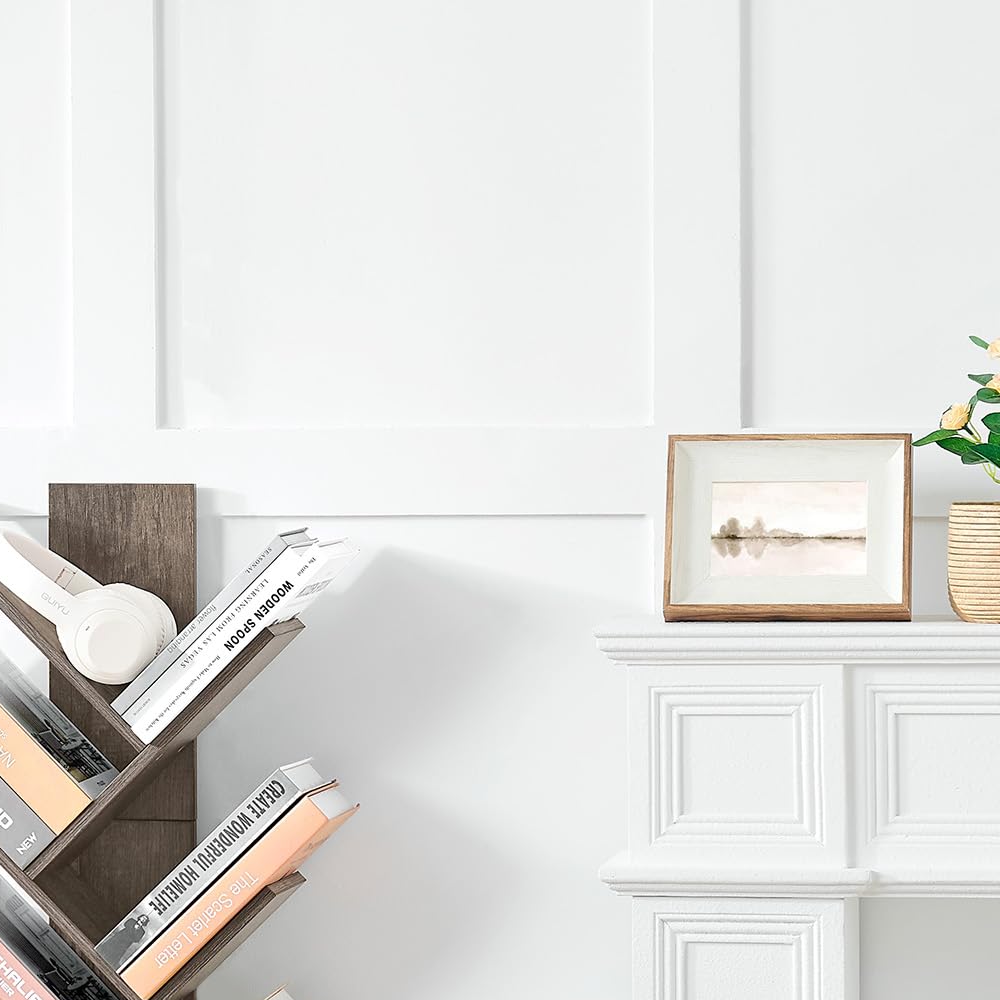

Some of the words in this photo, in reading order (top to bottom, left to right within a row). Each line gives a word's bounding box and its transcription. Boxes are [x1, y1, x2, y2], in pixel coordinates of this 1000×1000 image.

[235, 579, 269, 611] LEARNING
[254, 581, 294, 620] WOODEN
[197, 604, 217, 624] flower
[216, 612, 235, 632] FROM
[167, 622, 197, 654] arranging
[203, 632, 216, 644] LAS
[224, 619, 256, 651] SPOON
[180, 647, 203, 667] VEGAS
[246, 780, 285, 819] CREATE
[16, 832, 39, 855] NEW
[192, 812, 255, 871] WONDERFUL
[149, 865, 200, 916] HOMELIFE
[230, 872, 259, 895] The
[187, 893, 233, 936] Scarlet
[155, 932, 192, 968] Letter
